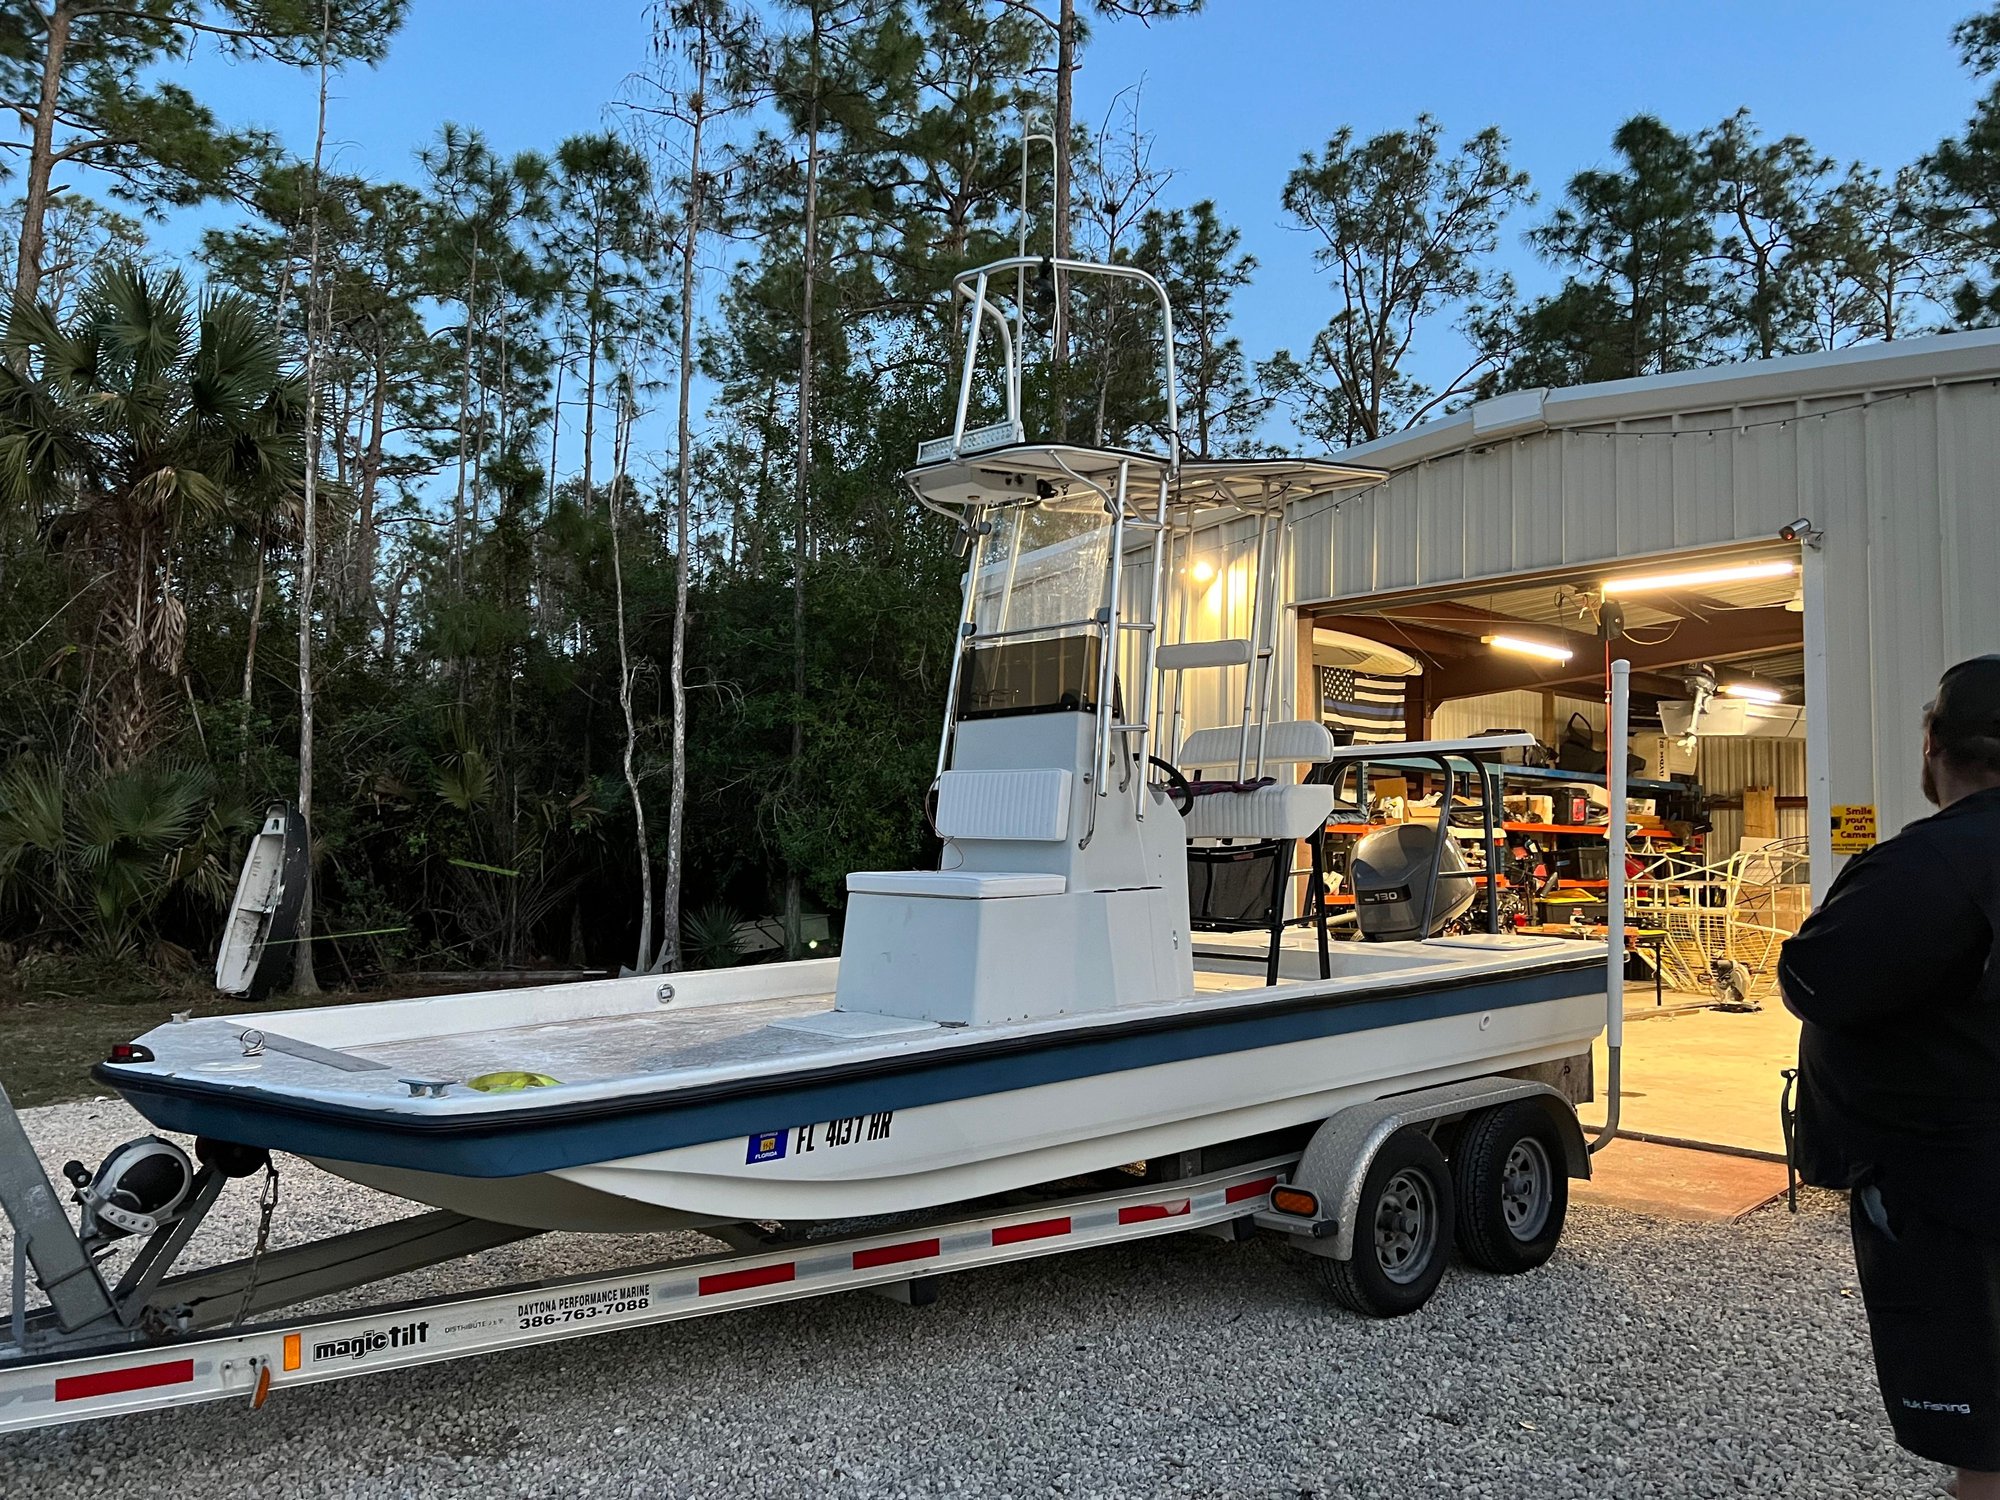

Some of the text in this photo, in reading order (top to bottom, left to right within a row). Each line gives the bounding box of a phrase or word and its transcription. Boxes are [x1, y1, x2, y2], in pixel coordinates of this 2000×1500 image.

[1846, 807, 1873, 815] Smile
[1845, 816, 1874, 825] you're
[796, 1125, 815, 1154] FL
[867, 1110, 893, 1140] HR
[754, 1150, 778, 1159] FLORIDA
[518, 1284, 650, 1317] DAYTONA PERFORMANCE MARINE
[519, 1298, 649, 1329] 386-763-7088
[1923, 1401, 1970, 1414] Fishing
